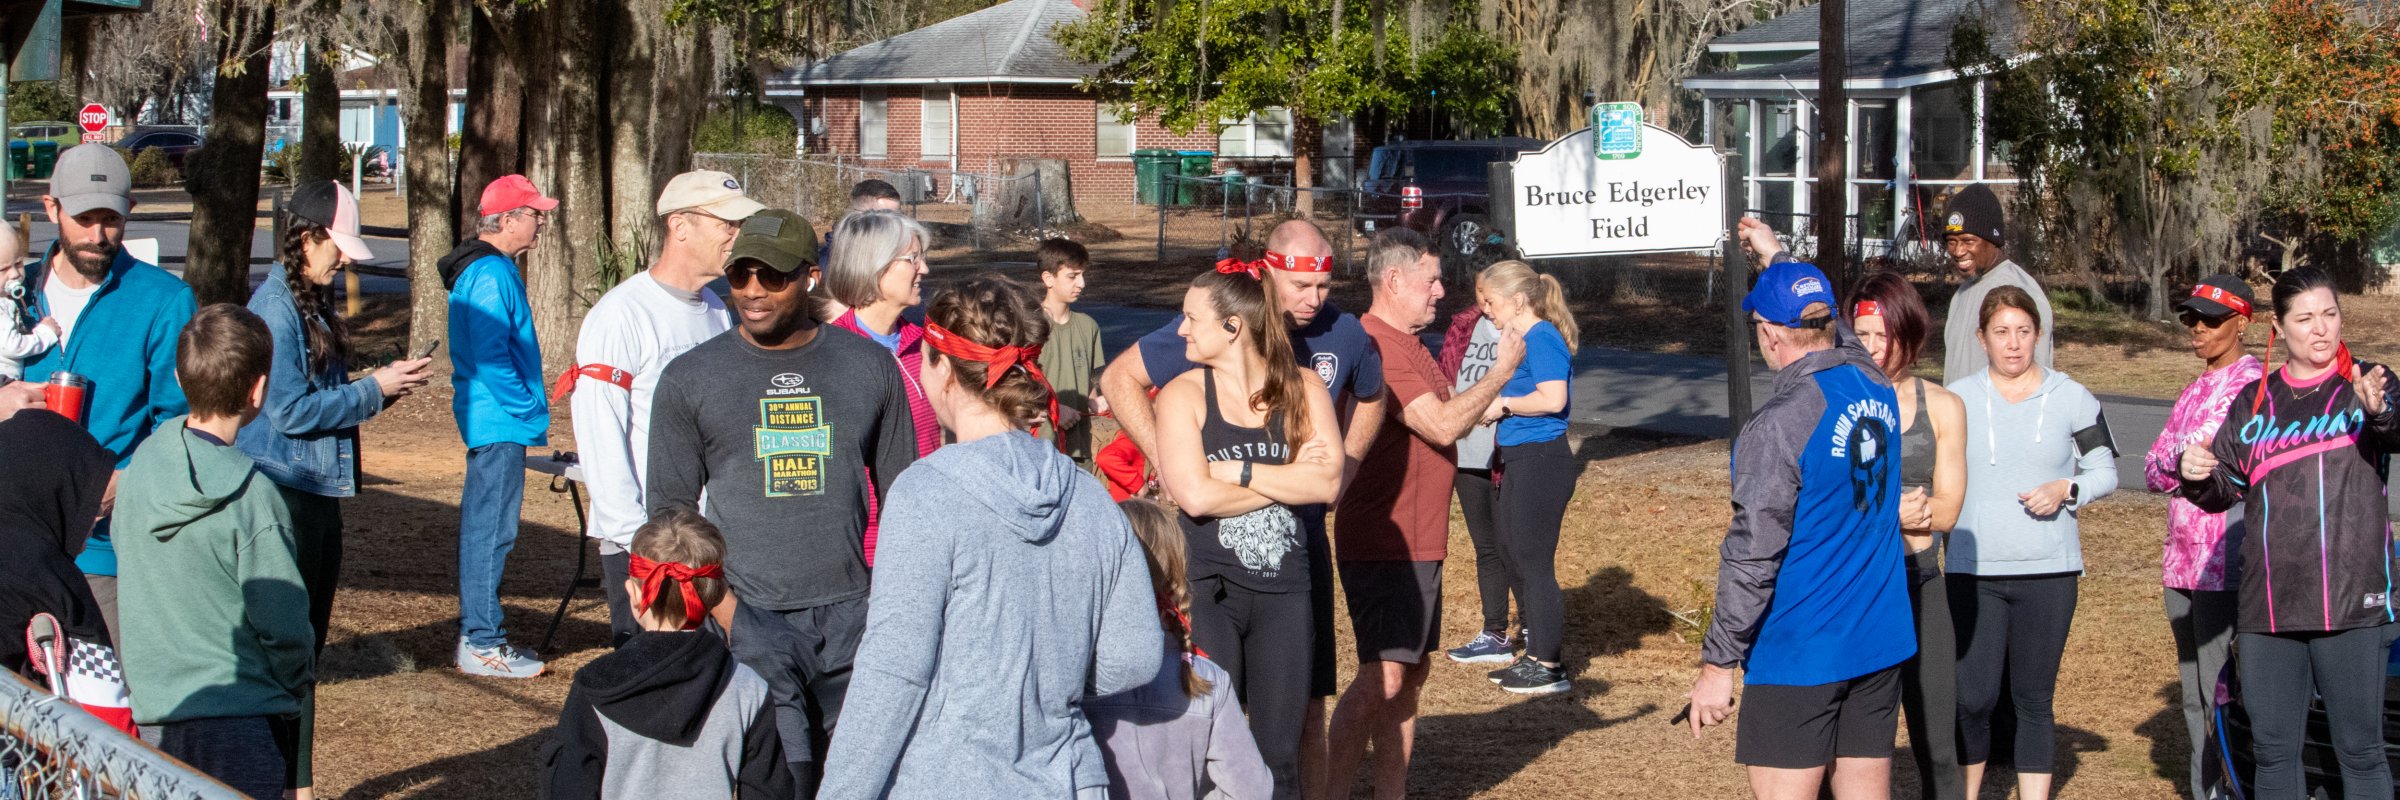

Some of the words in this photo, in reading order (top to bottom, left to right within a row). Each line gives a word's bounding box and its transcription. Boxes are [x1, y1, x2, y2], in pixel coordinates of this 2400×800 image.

[82, 112, 106, 124] STOP
[1524, 185, 1597, 207] Bruce
[1608, 179, 1710, 208] Edgerley
[1590, 216, 1649, 239] Field
[766, 387, 811, 395] SUBARU
[785, 402, 813, 411] ANNUAL
[769, 413, 814, 425] DISTANCE
[1831, 413, 1853, 458] RONIN
[1847, 399, 1896, 433] SPARTANS
[761, 432, 825, 450] CLASSIC
[772, 457, 817, 471] HALF
[773, 469, 817, 478] MARATHON
[794, 479, 817, 491] 2013
